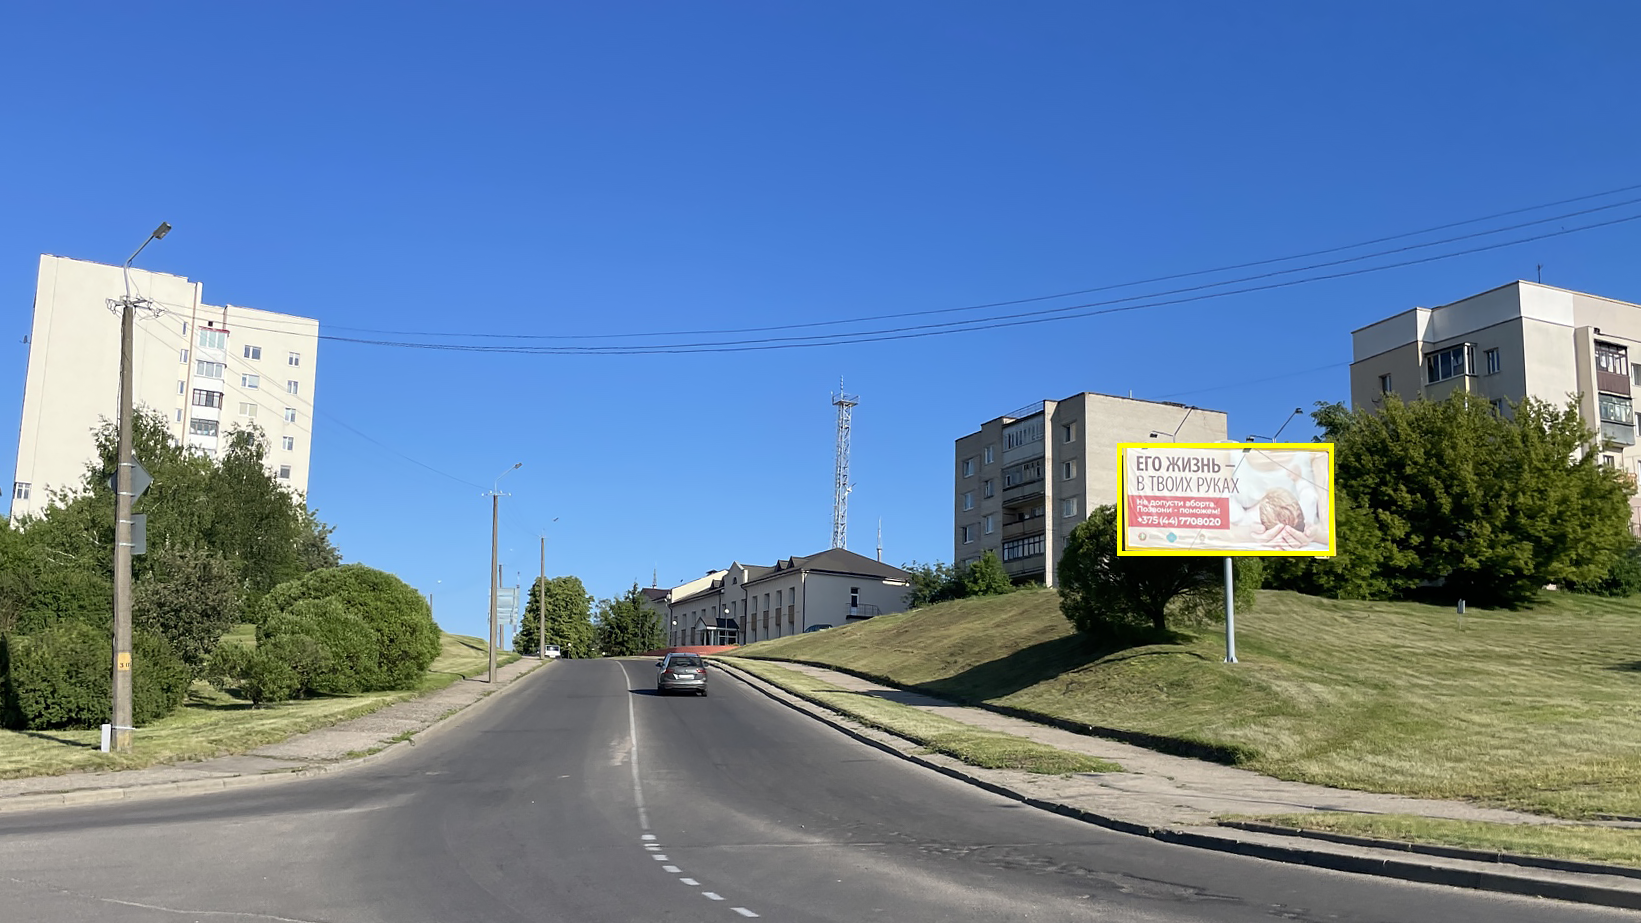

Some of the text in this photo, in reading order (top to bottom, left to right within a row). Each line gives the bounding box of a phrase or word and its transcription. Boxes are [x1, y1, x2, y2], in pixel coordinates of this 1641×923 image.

[1136, 455, 1162, 472] ЕГО
[1166, 456, 1221, 473] ЖИЗНЬ
[1136, 475, 1240, 494] В ТВОИХ РУКАХ
[1149, 499, 1184, 507] допусти
[1179, 507, 1221, 515] поможем!
[1137, 516, 1221, 526] +375 (44) 7708020
